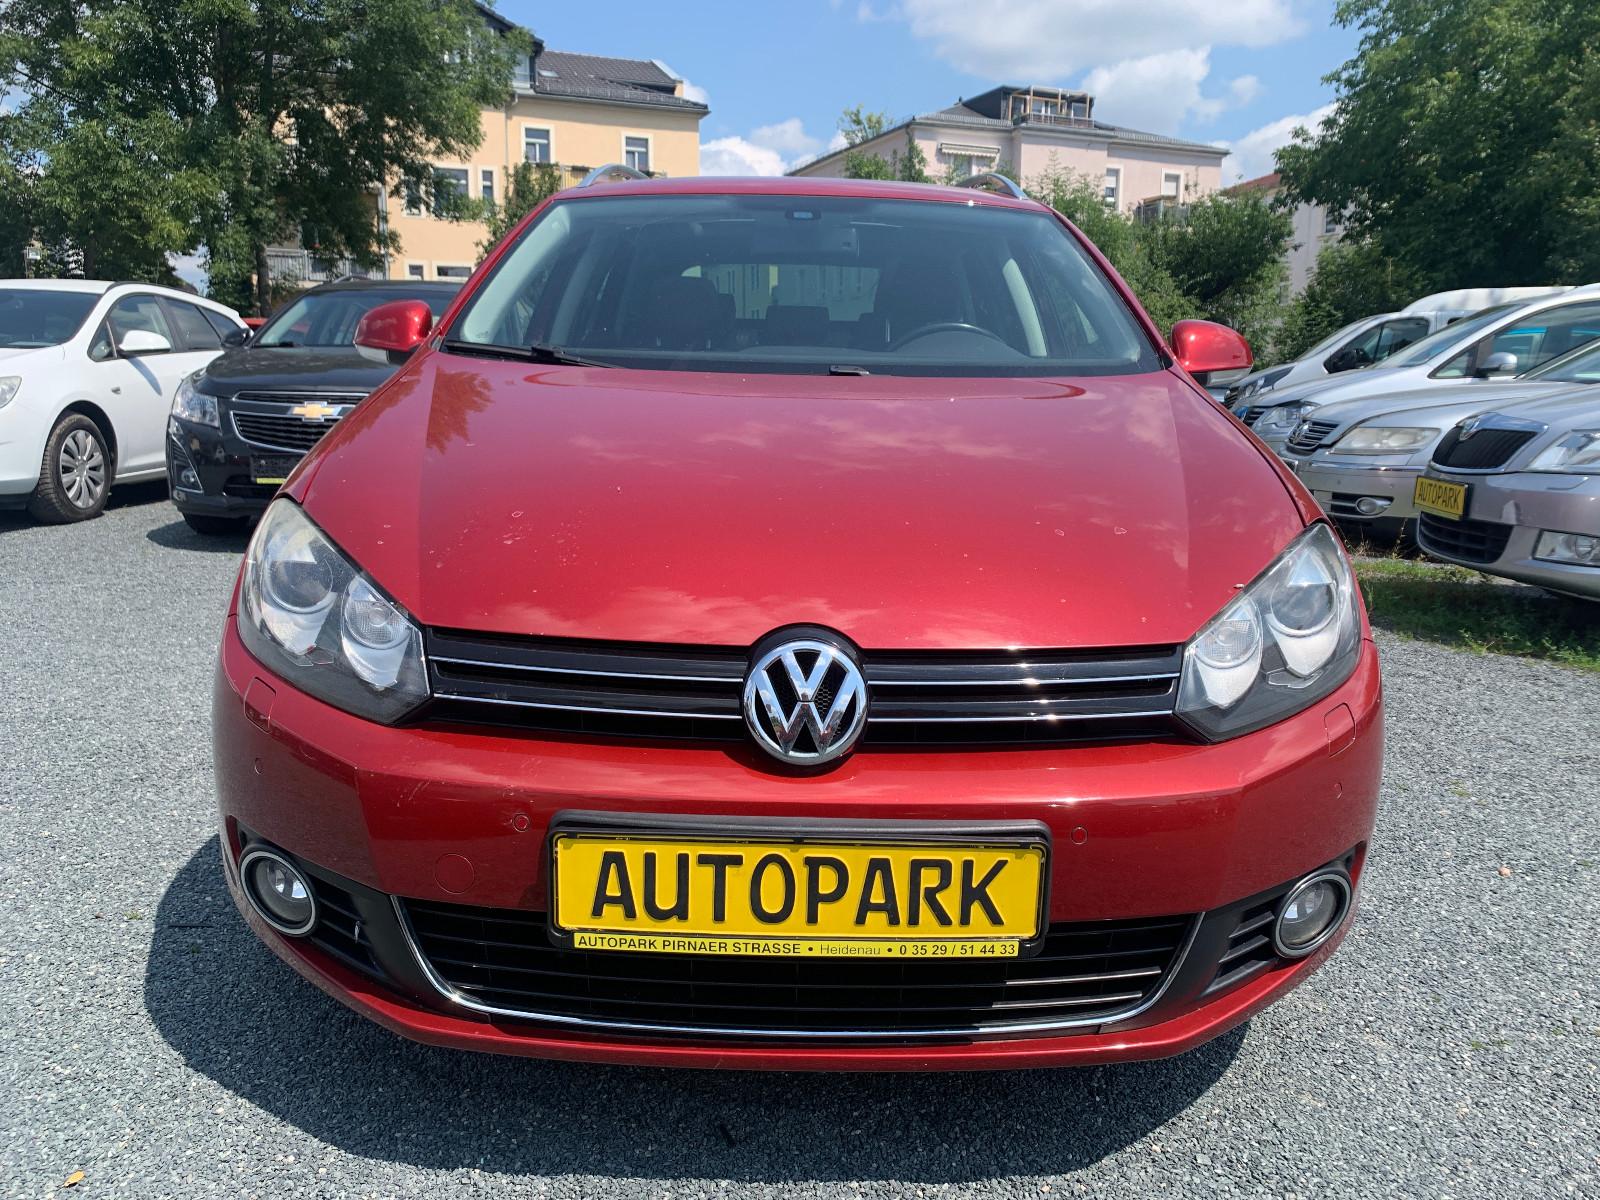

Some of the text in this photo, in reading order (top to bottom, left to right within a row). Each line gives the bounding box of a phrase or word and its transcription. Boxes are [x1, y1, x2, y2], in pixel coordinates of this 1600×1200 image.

[1418, 480, 1461, 511] AUTOPARK
[591, 851, 1009, 927] AUTOPARK
[578, 935, 658, 950] AUTOPARK
[662, 939, 728, 952] PIRNAER
[732, 942, 801, 954] STRASSE
[820, 943, 881, 955] Heidenau
[899, 945, 907, 955] 0
[912, 945, 927, 955] 35
[932, 945, 947, 955] 29
[960, 945, 975, 955] 51
[980, 945, 995, 955] 44
[1000, 944, 1015, 954] 33
